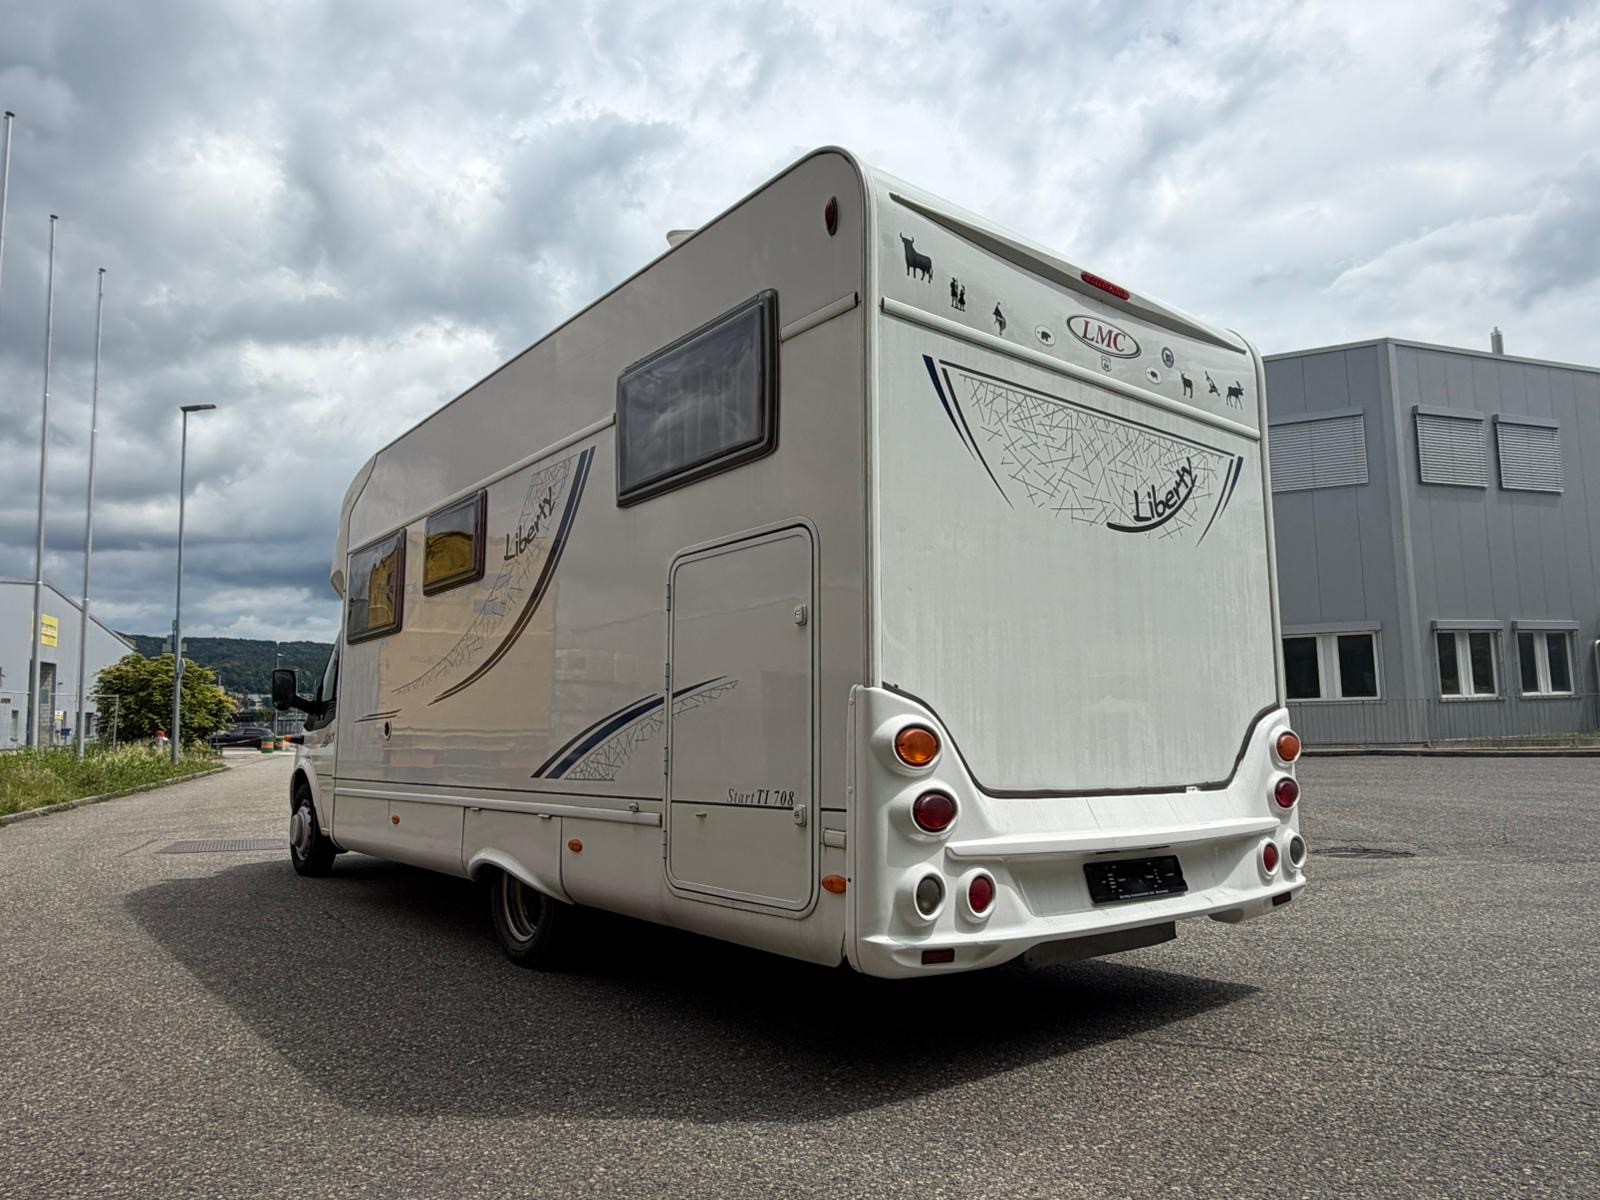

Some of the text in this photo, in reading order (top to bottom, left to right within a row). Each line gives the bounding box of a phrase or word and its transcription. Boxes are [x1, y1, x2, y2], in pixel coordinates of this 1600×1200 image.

[1081, 320, 1126, 352] LMC
[1133, 456, 1198, 522] Liberty
[503, 486, 556, 561] Liberty
[727, 788, 755, 804] Start
[774, 790, 795, 806] 708
